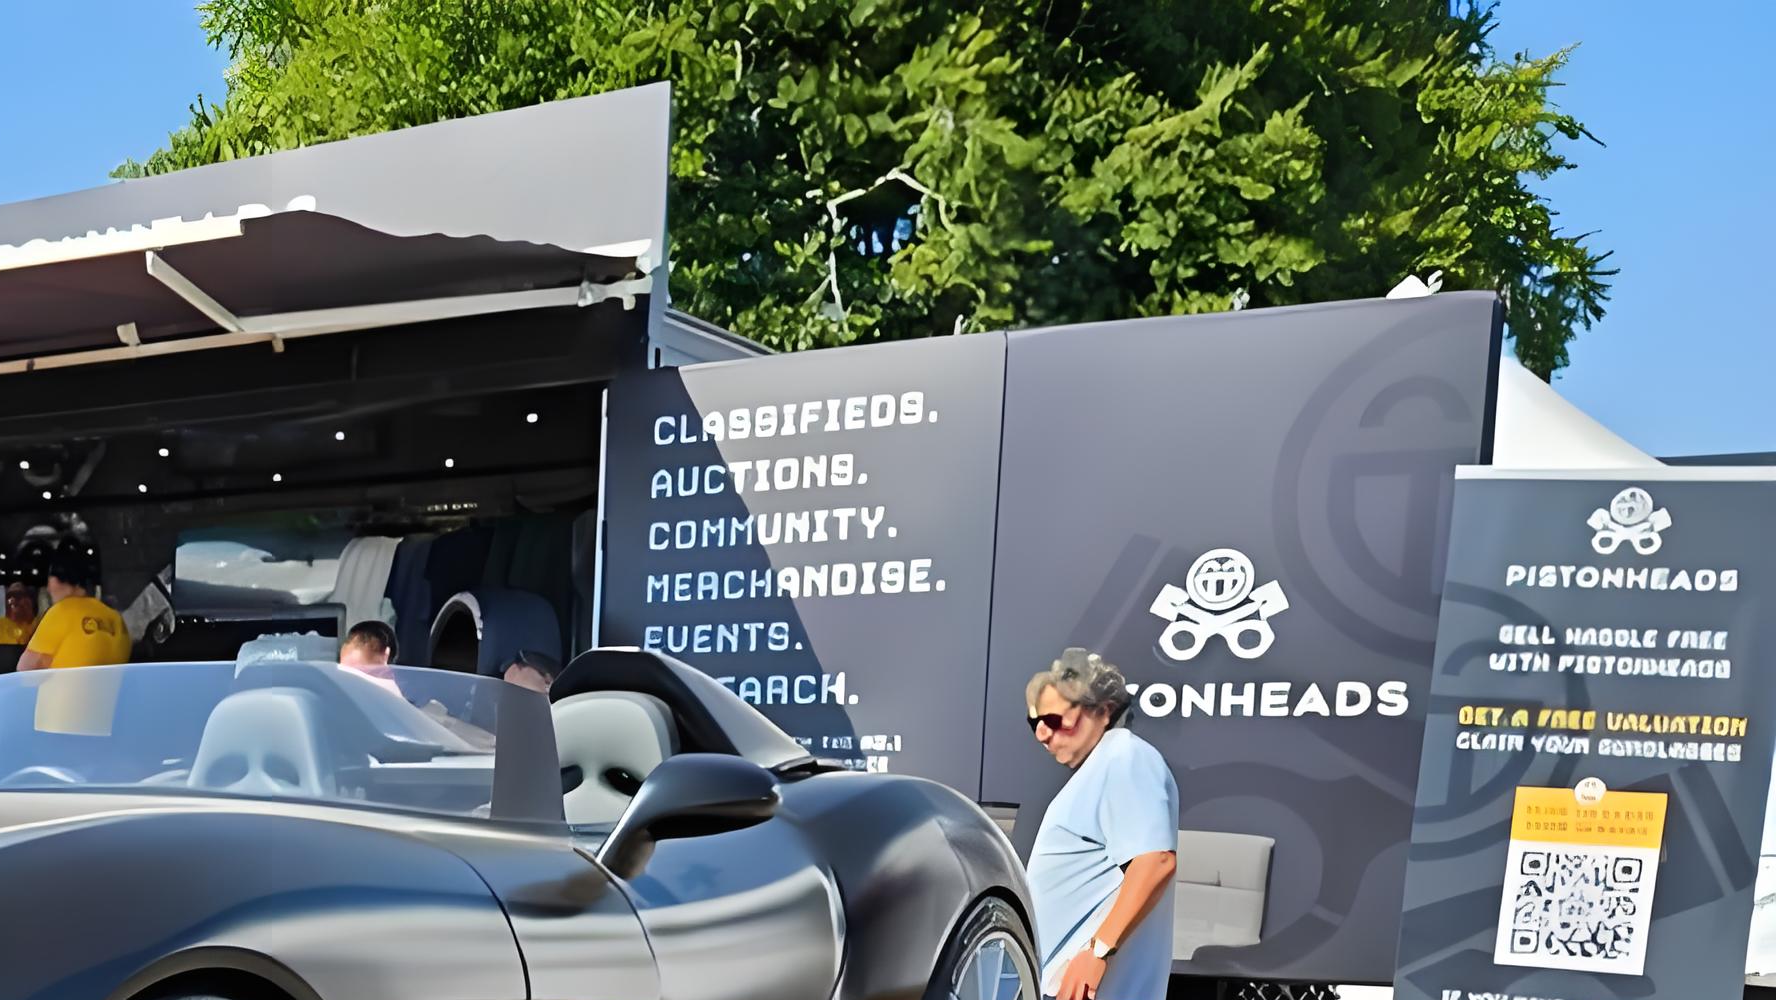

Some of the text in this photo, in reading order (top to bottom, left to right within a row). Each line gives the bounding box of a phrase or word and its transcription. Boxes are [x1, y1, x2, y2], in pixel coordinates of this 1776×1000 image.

[653, 391, 939, 446] CLASSIFIEDS.
[648, 505, 898, 551] COMMUNITY.
[1505, 564, 1739, 592] PISTONHEADS
[642, 621, 804, 654] EVENTS.
[1126, 680, 1410, 719] ONHEADS
